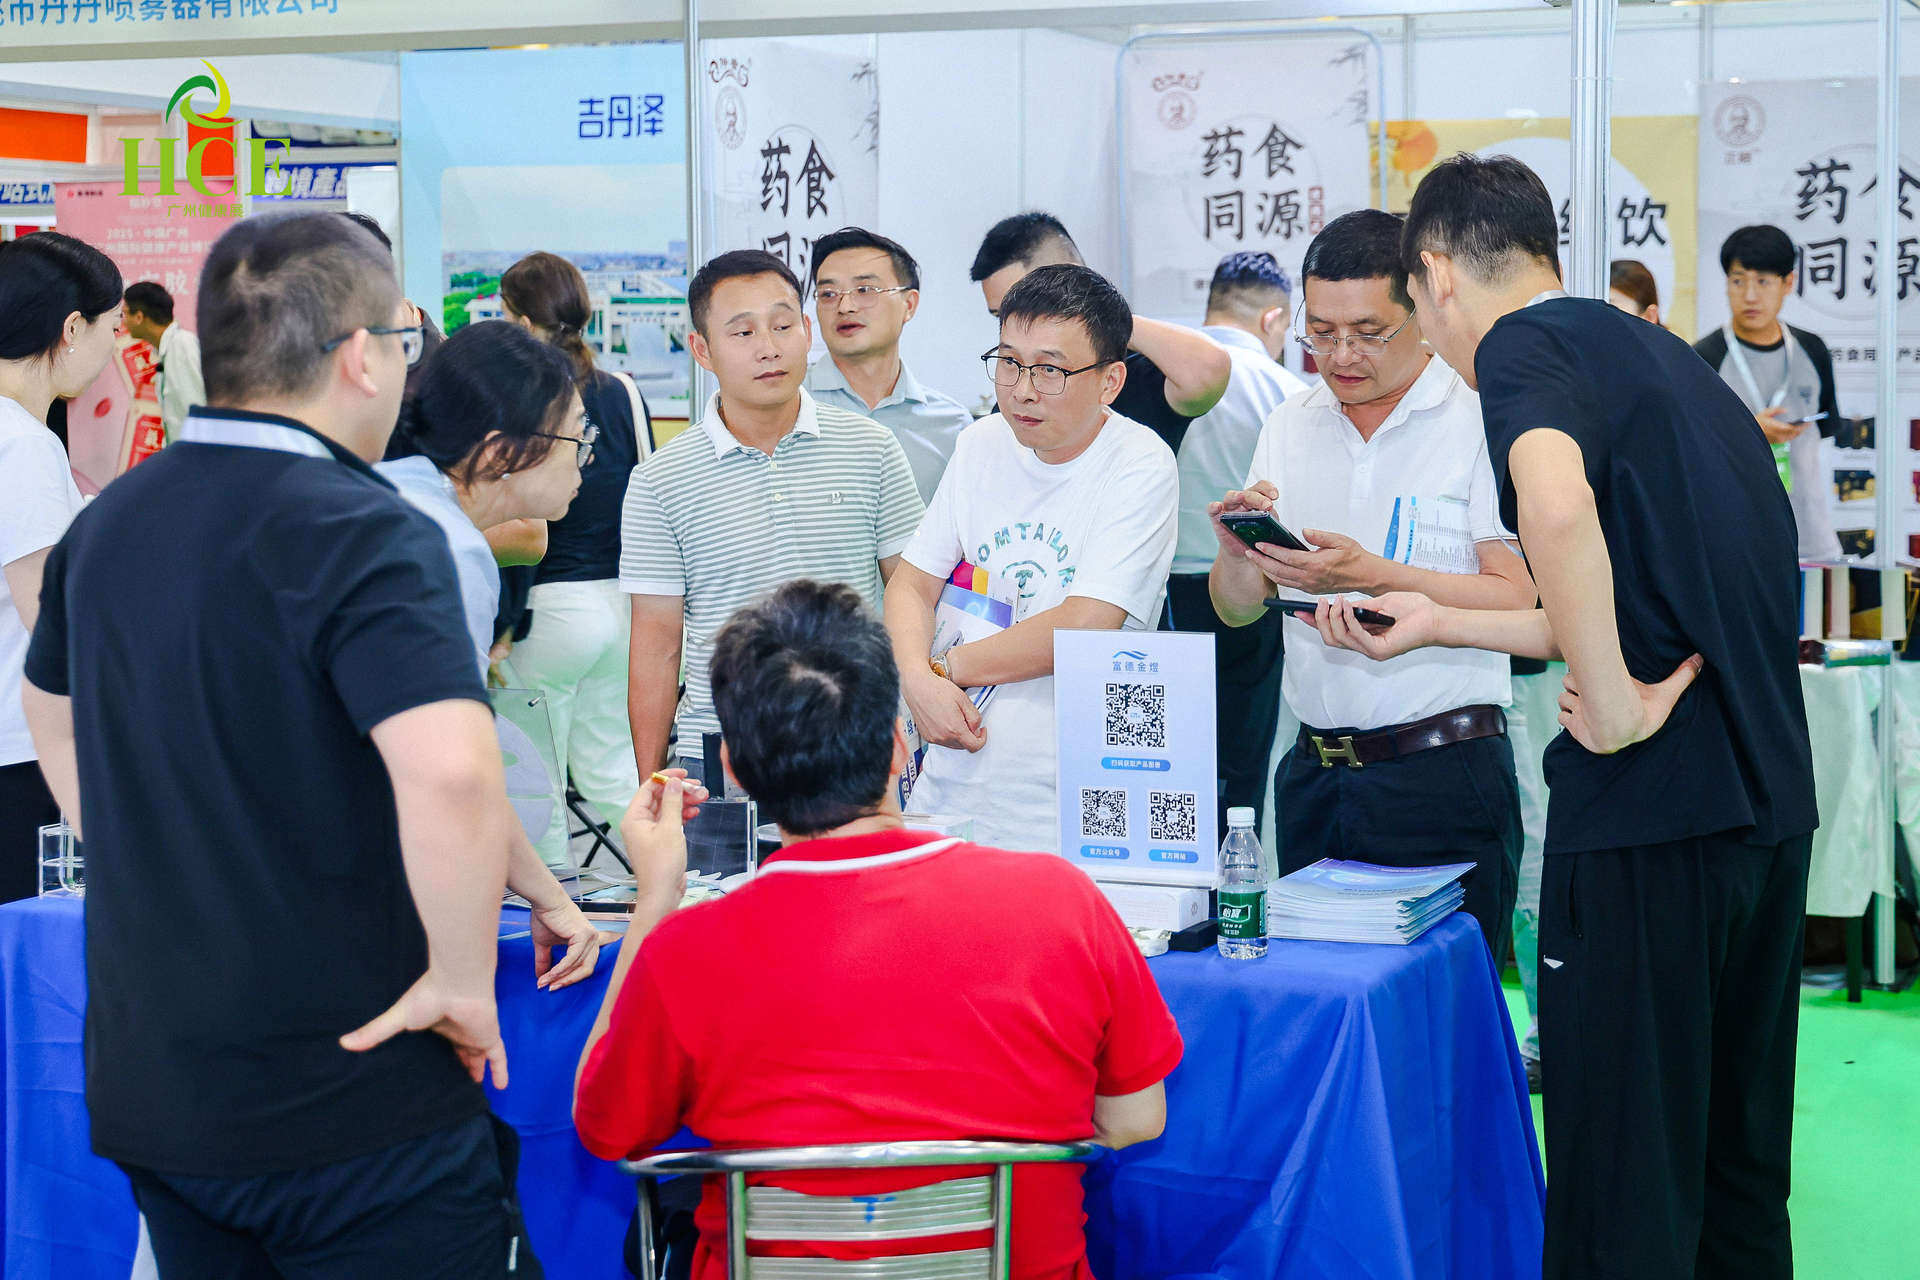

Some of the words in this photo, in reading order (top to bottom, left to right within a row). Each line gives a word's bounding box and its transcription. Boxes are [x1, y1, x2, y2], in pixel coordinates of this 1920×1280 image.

[579, 95, 663, 138] 吉丹泽
[760, 136, 835, 219] 药食
[1202, 124, 1304, 180] 药食
[1203, 190, 1304, 241] 同源
